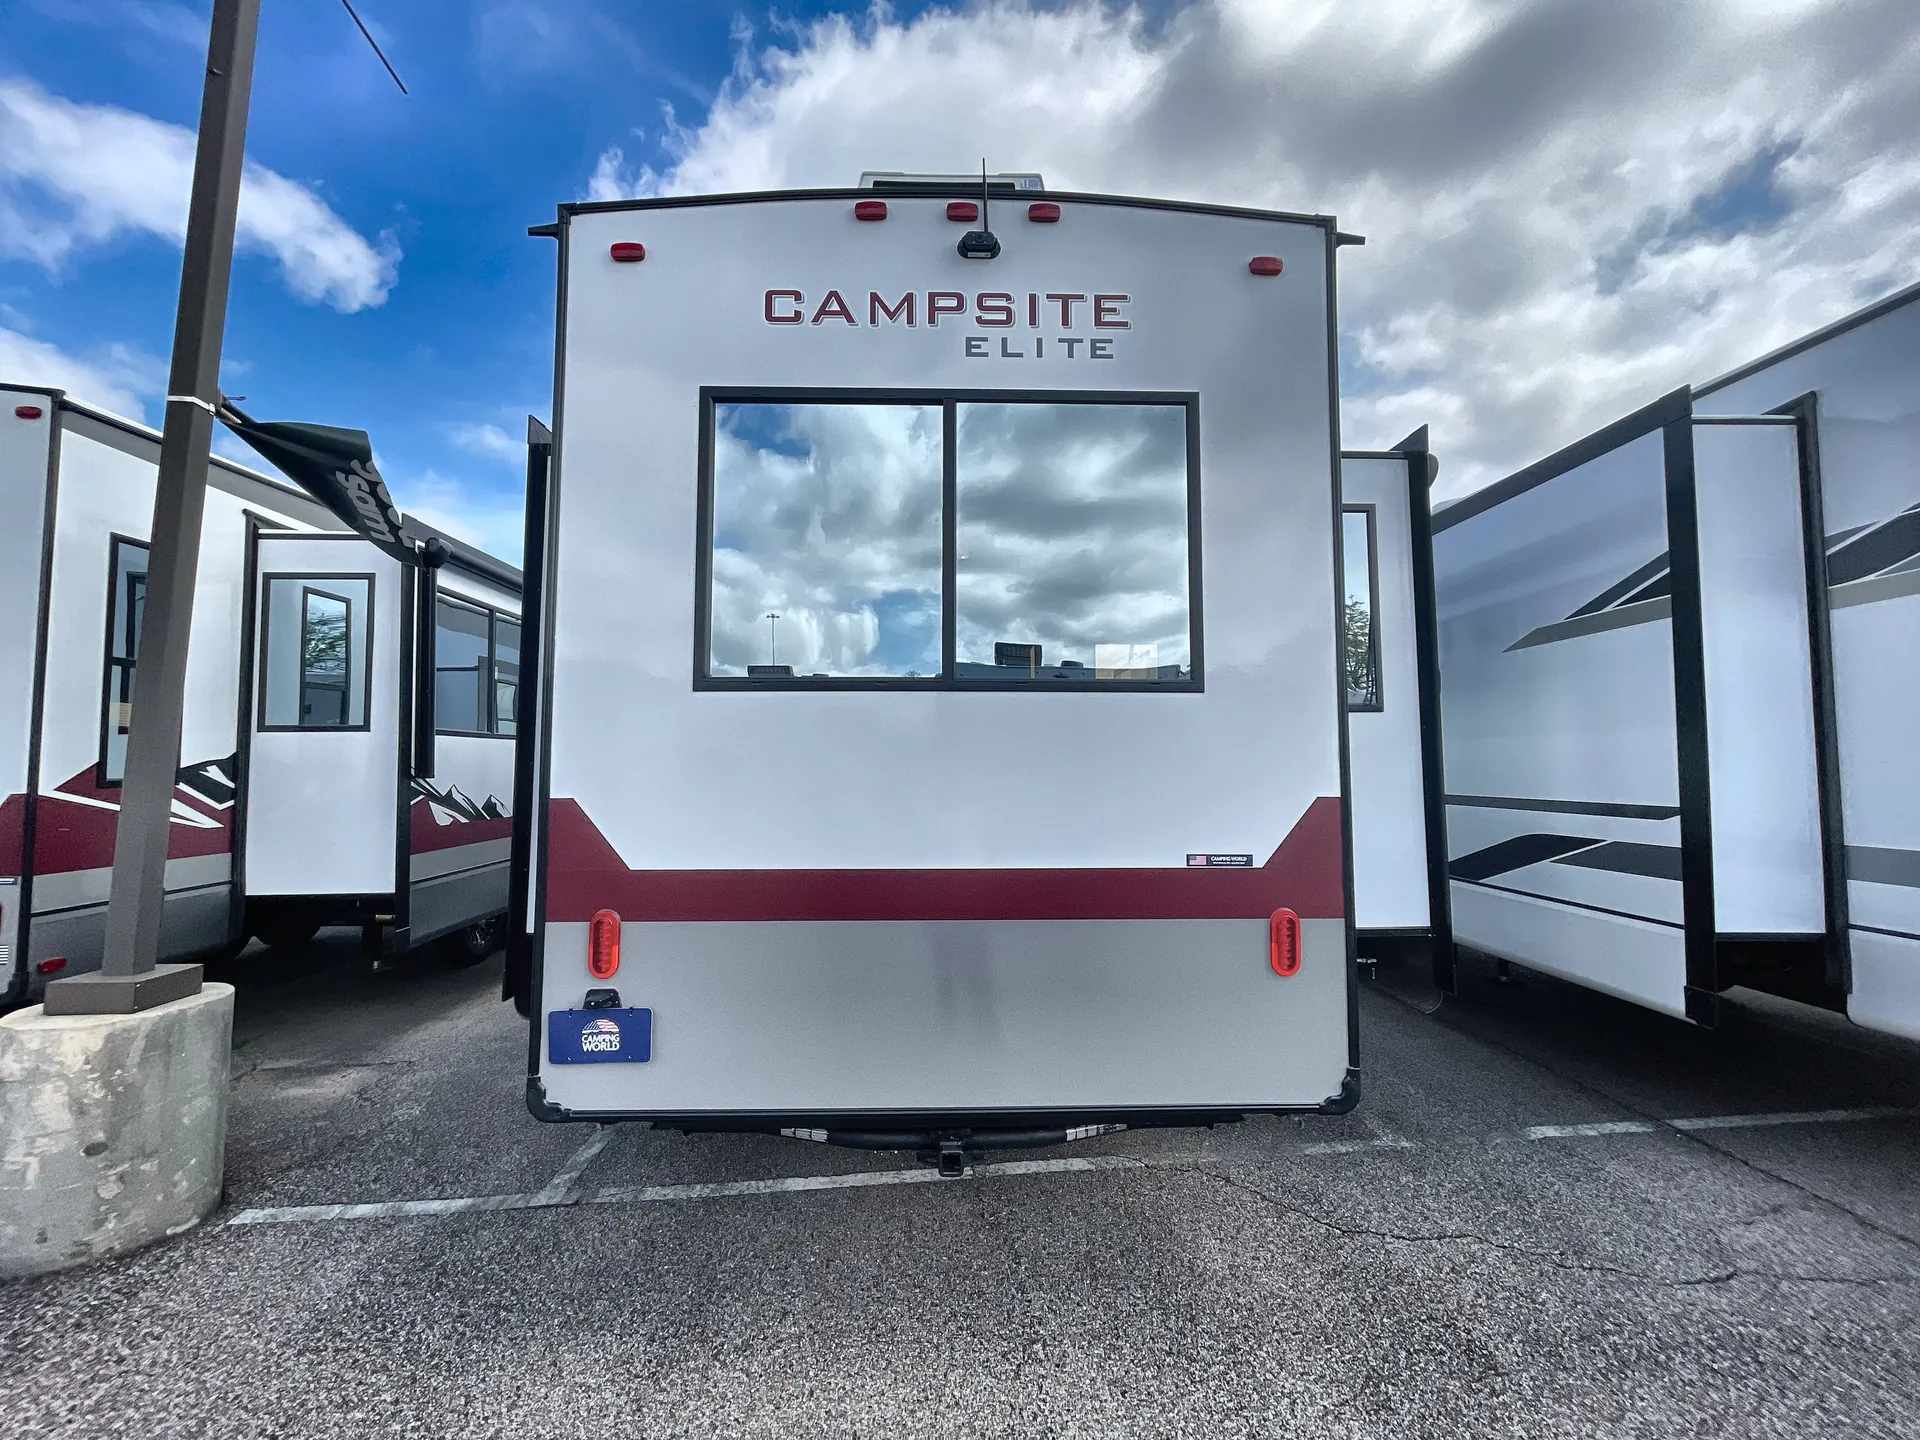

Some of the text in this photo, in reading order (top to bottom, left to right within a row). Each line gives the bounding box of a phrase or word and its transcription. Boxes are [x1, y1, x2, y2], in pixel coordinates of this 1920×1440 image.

[764, 288, 1131, 329] CAMPSITE
[965, 336, 1114, 359] ELITE
[582, 1034, 619, 1042] CAMPING
[582, 1042, 619, 1051] WORLD
